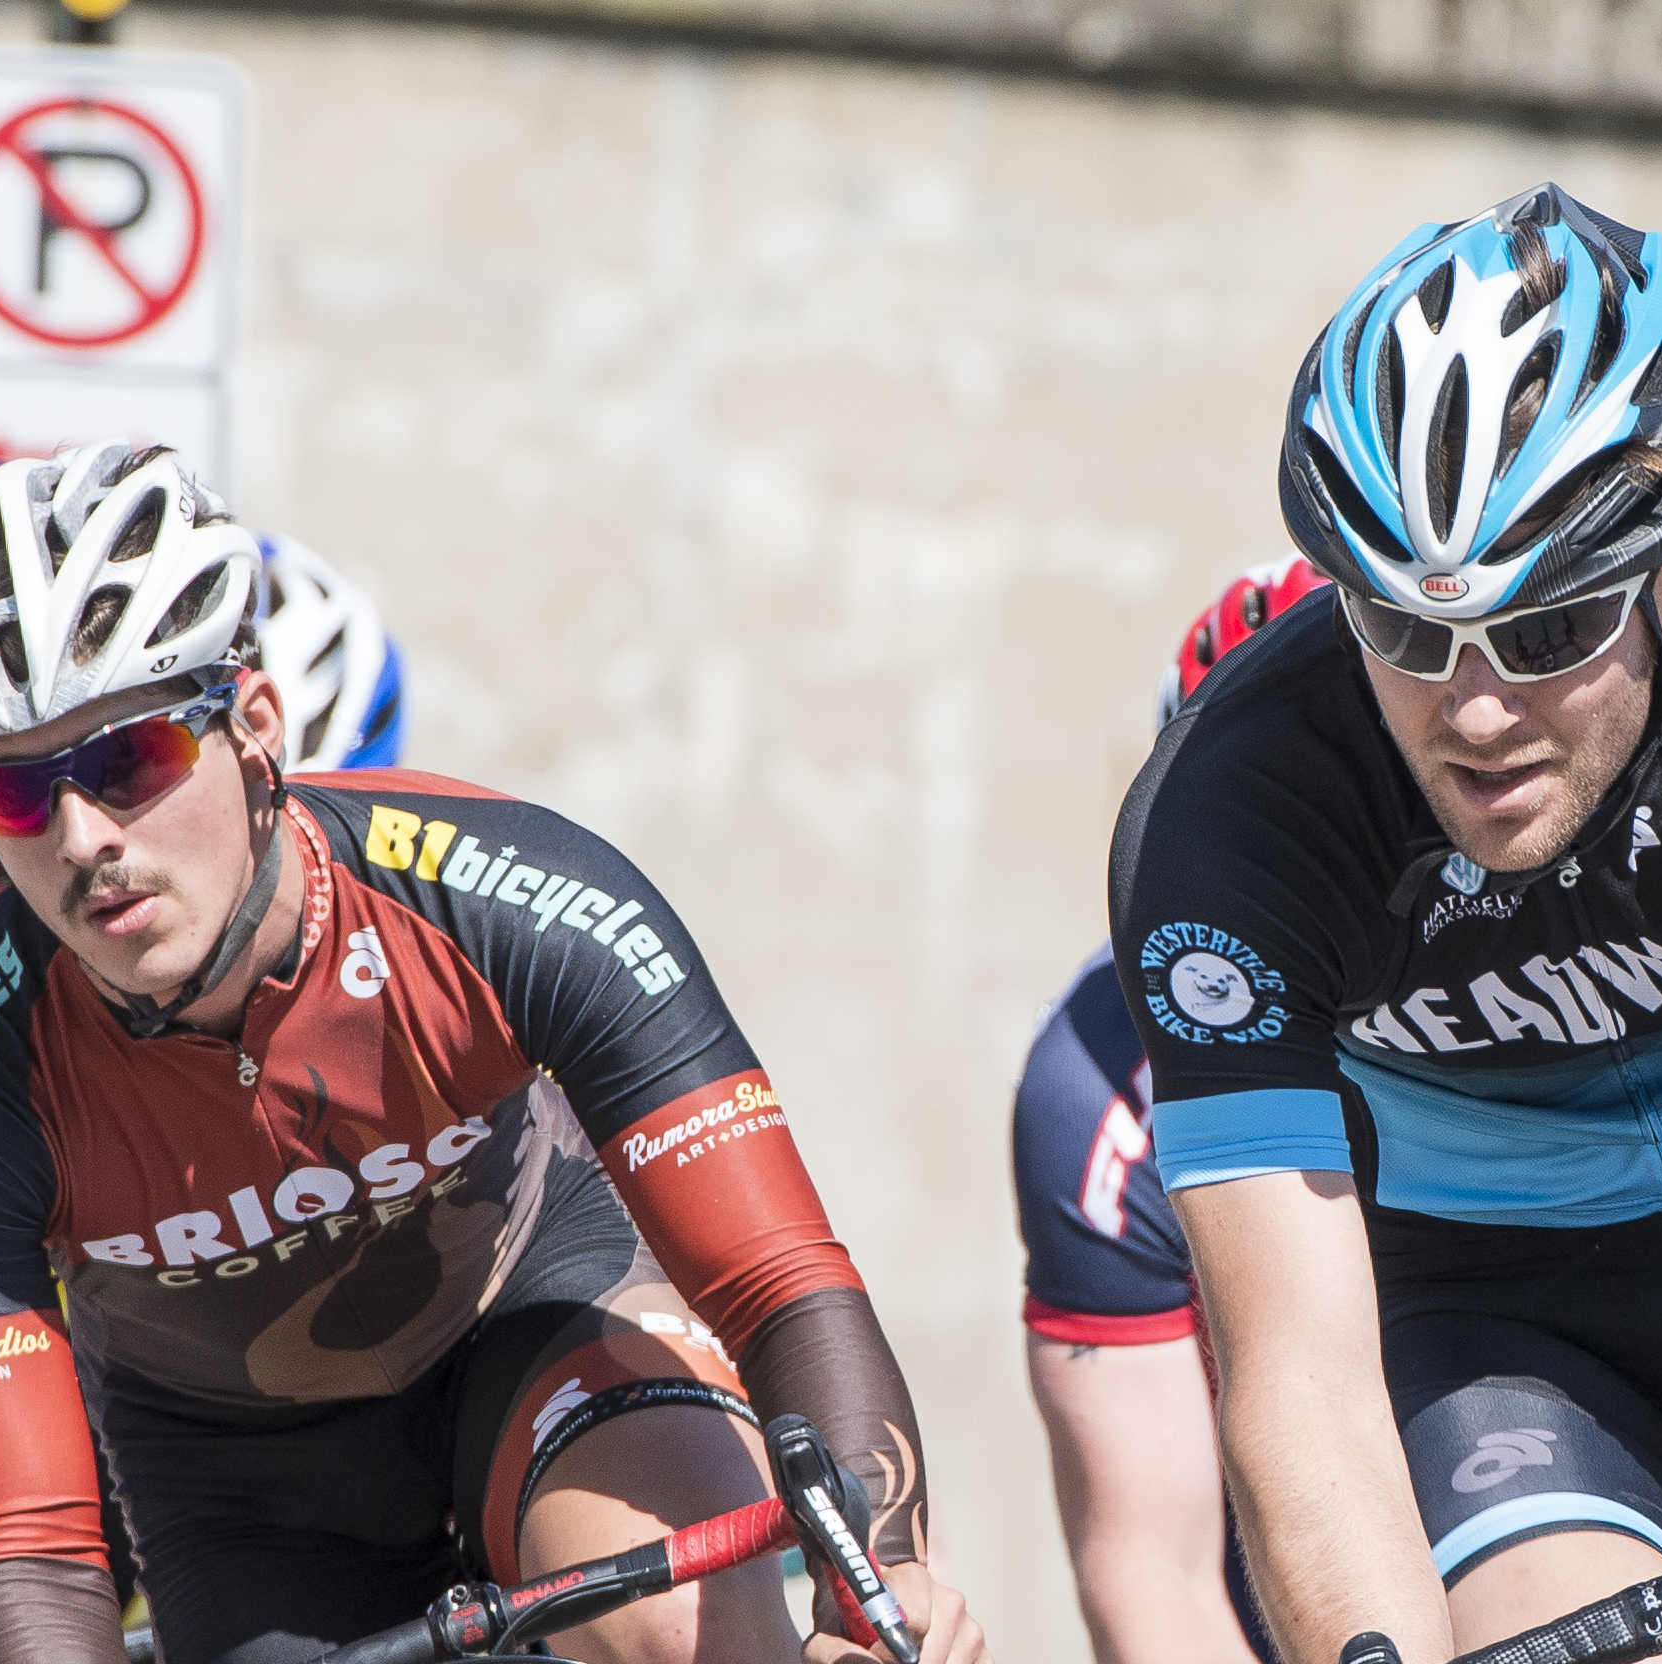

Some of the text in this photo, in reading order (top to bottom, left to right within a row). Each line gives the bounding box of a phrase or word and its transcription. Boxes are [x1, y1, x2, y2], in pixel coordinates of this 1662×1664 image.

[1425, 580, 1459, 592] BELL
[1145, 993, 1214, 1044] BIKE
[623, 1099, 738, 1172] Rumora
[157, 1166, 469, 1288] COFFEE
[803, 1485, 880, 1594] SRAM
[511, 1570, 585, 1610] DINAMO
